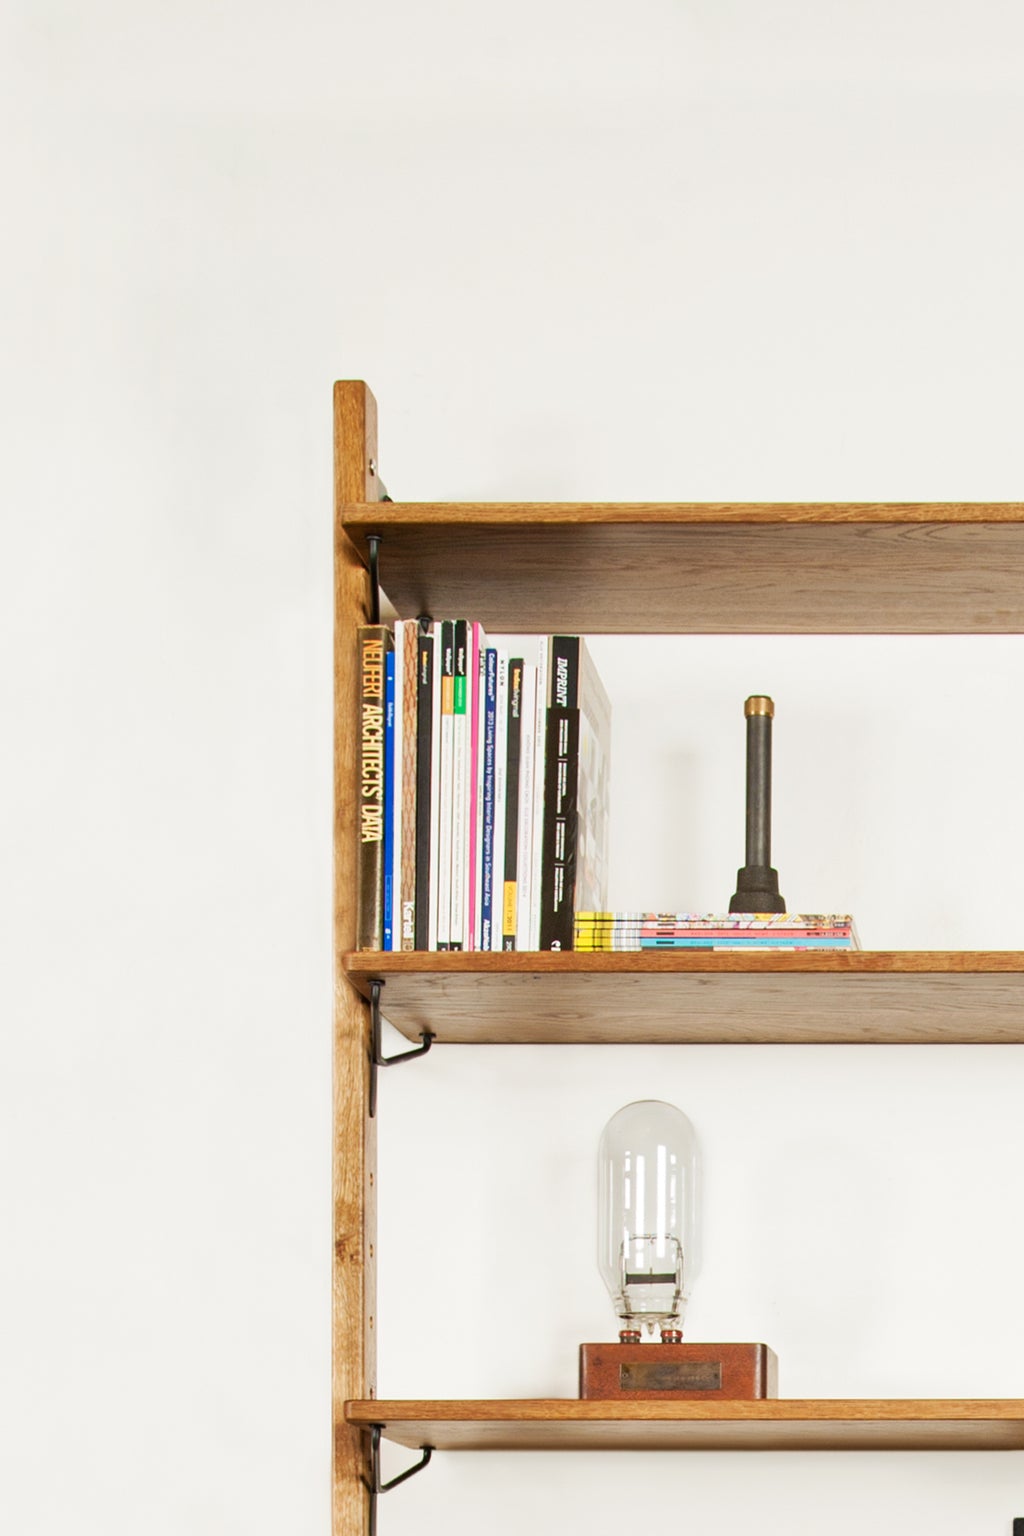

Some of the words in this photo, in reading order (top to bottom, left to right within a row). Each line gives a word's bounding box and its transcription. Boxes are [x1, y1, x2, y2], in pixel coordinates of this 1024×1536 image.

[363, 639, 383, 700] NEUFERT
[556, 657, 567, 707] IMPRINT
[361, 704, 383, 801] ARCHITECTS'
[486, 726, 494, 744] Living
[485, 766, 493, 774] by
[484, 775, 492, 801] Inspiring
[361, 805, 382, 843] DATA
[483, 825, 491, 855] Designers
[403, 901, 414, 939] Kartell
[482, 919, 490, 951] AkzoNob
